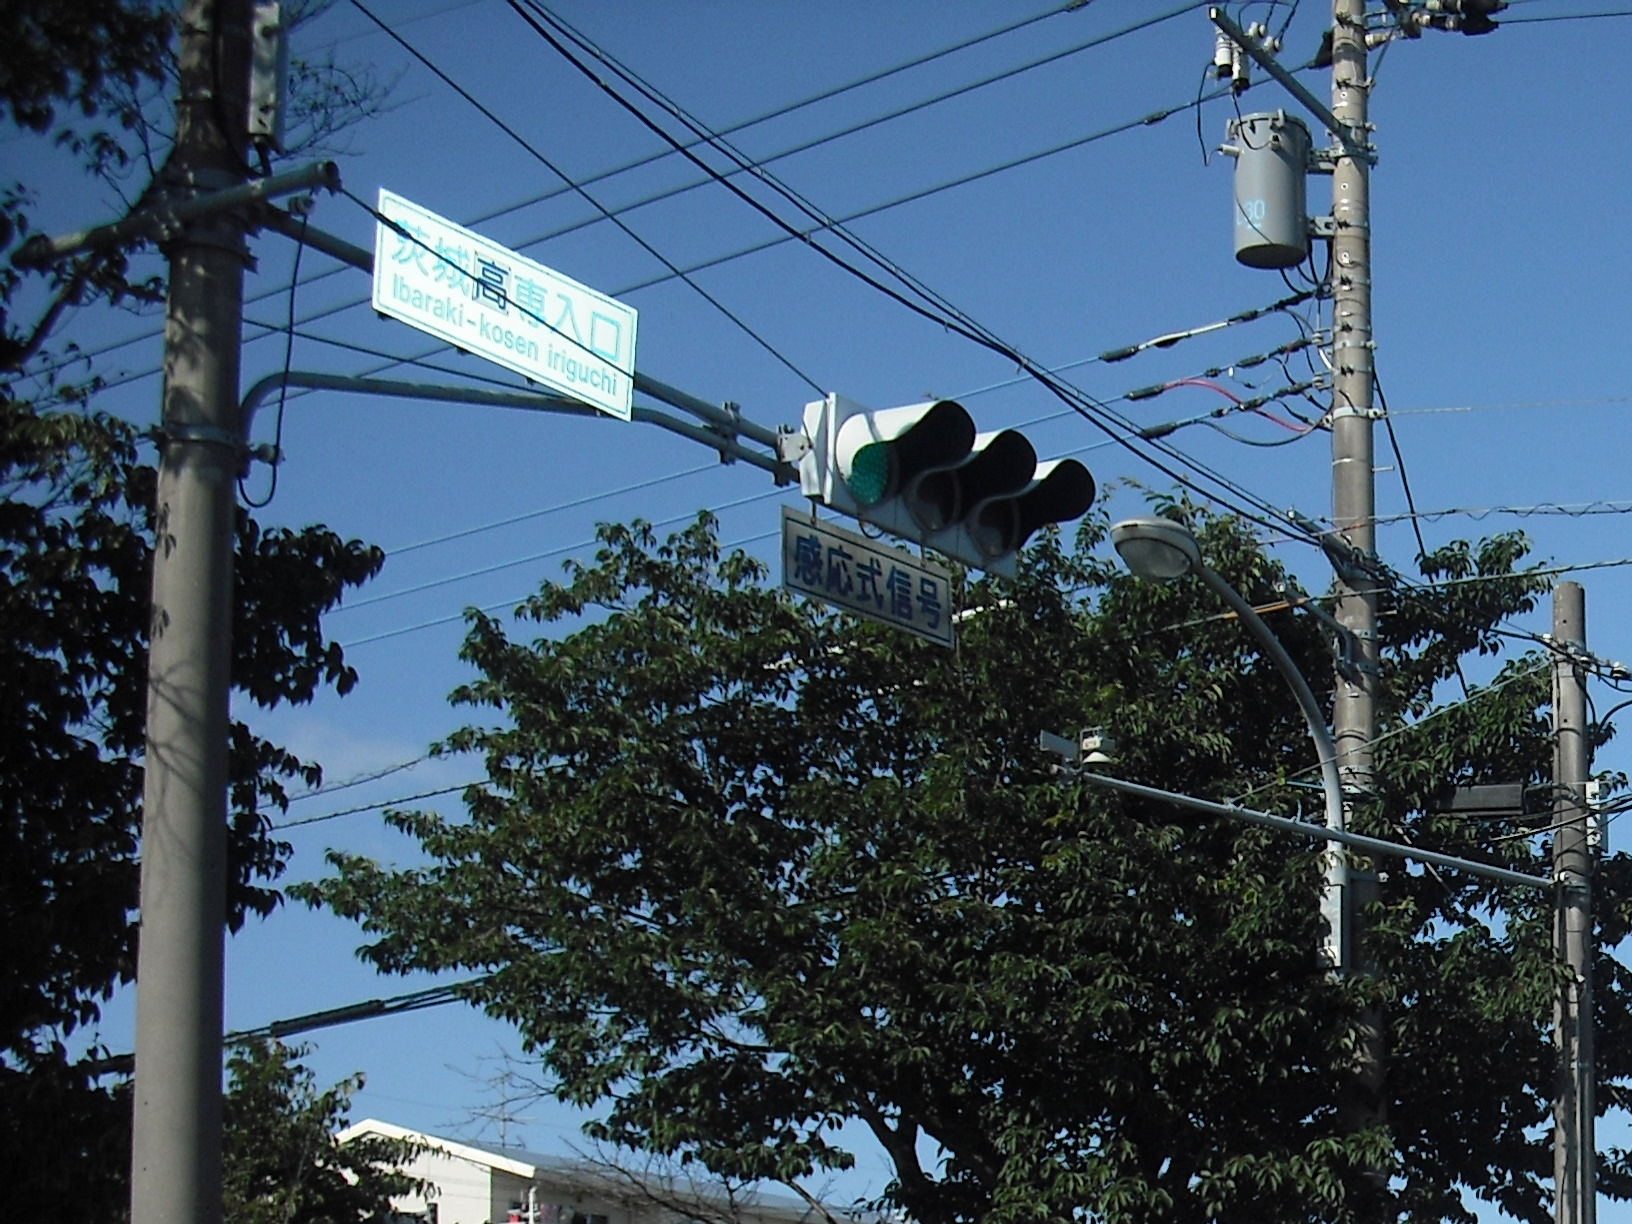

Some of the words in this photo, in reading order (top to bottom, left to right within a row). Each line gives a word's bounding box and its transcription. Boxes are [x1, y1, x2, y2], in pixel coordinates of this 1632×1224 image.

[391, 218, 622, 362] 茨城高専入口
[393, 272, 540, 361] Ibaraki-kosen
[546, 342, 617, 397] iriguchi
[794, 534, 941, 630] 感応式信号
